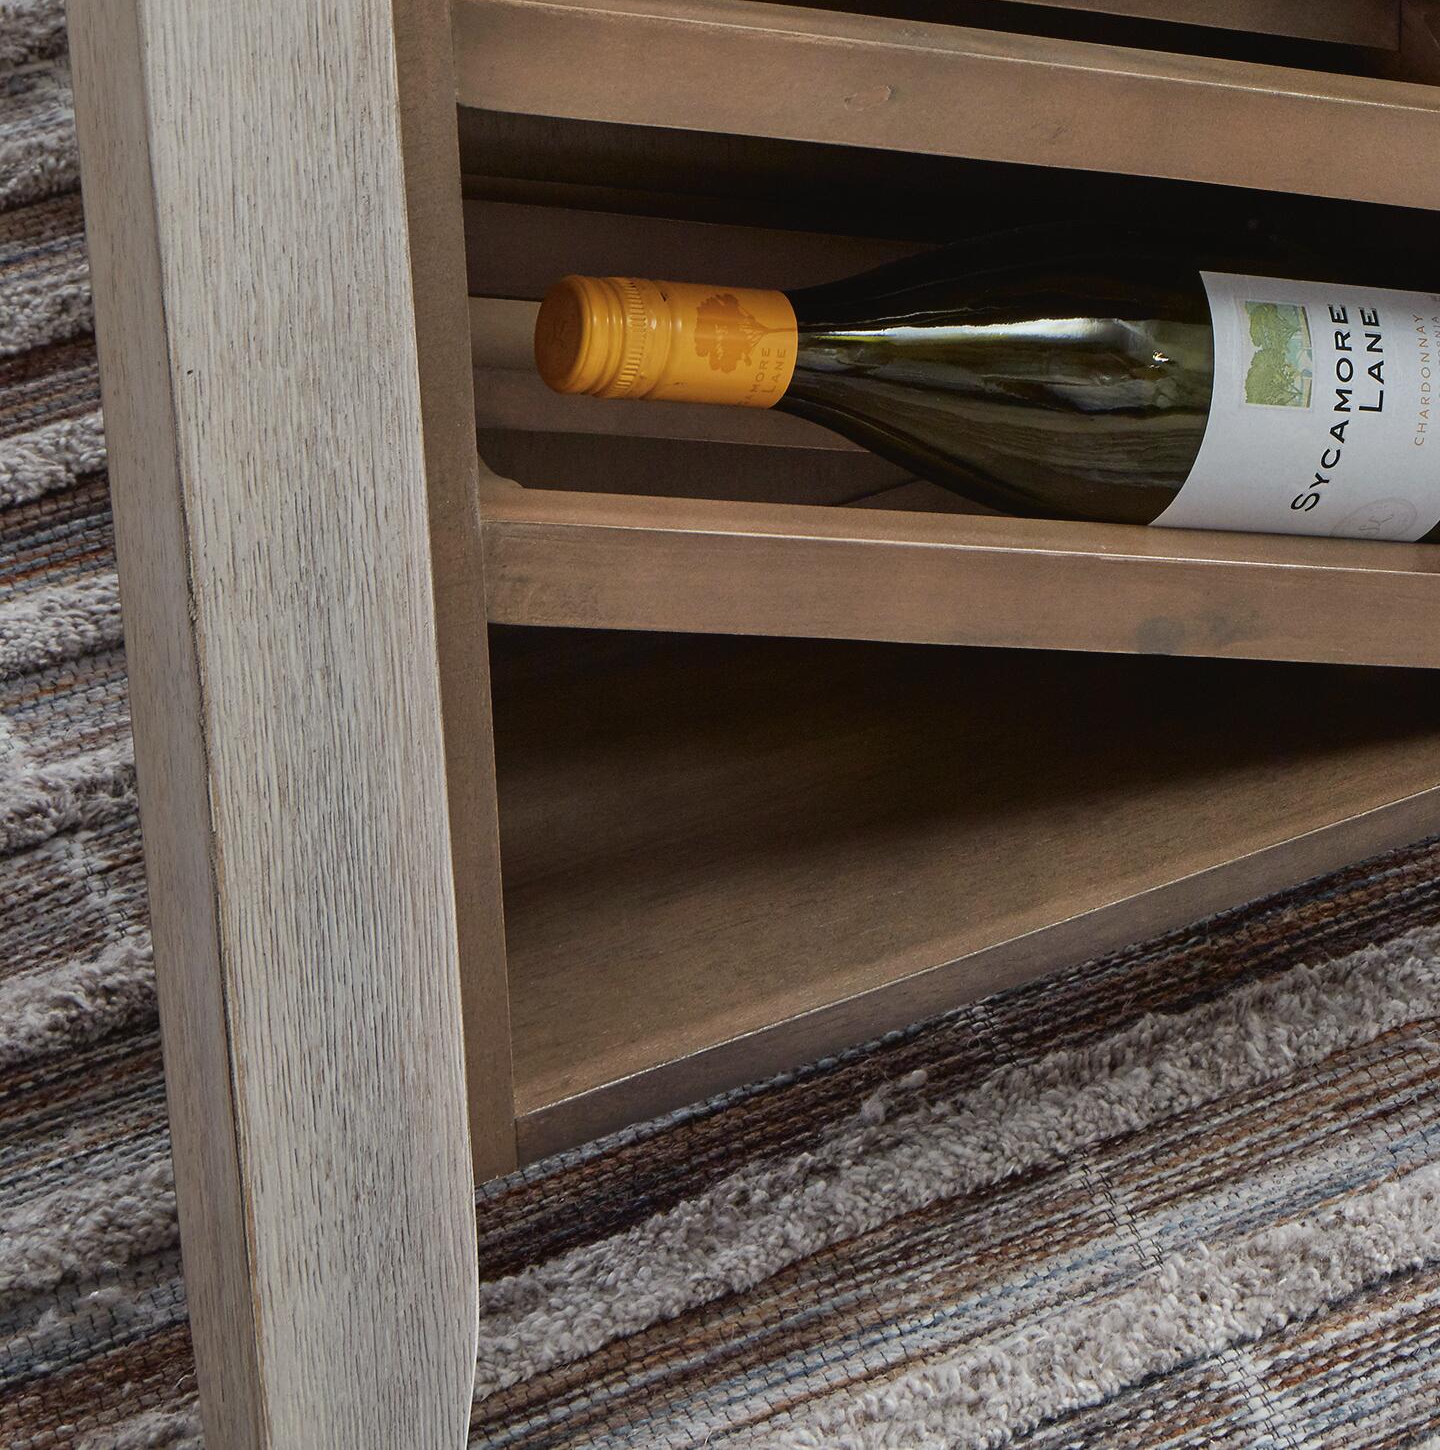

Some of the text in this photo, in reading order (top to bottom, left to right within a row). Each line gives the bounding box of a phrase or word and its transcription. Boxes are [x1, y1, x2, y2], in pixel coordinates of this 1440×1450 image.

[761, 348, 787, 394] LANE
[1290, 303, 1354, 513] SYCAMORE
[1358, 306, 1386, 413] LANE
[1413, 313, 1431, 447] CHARDONNAY
